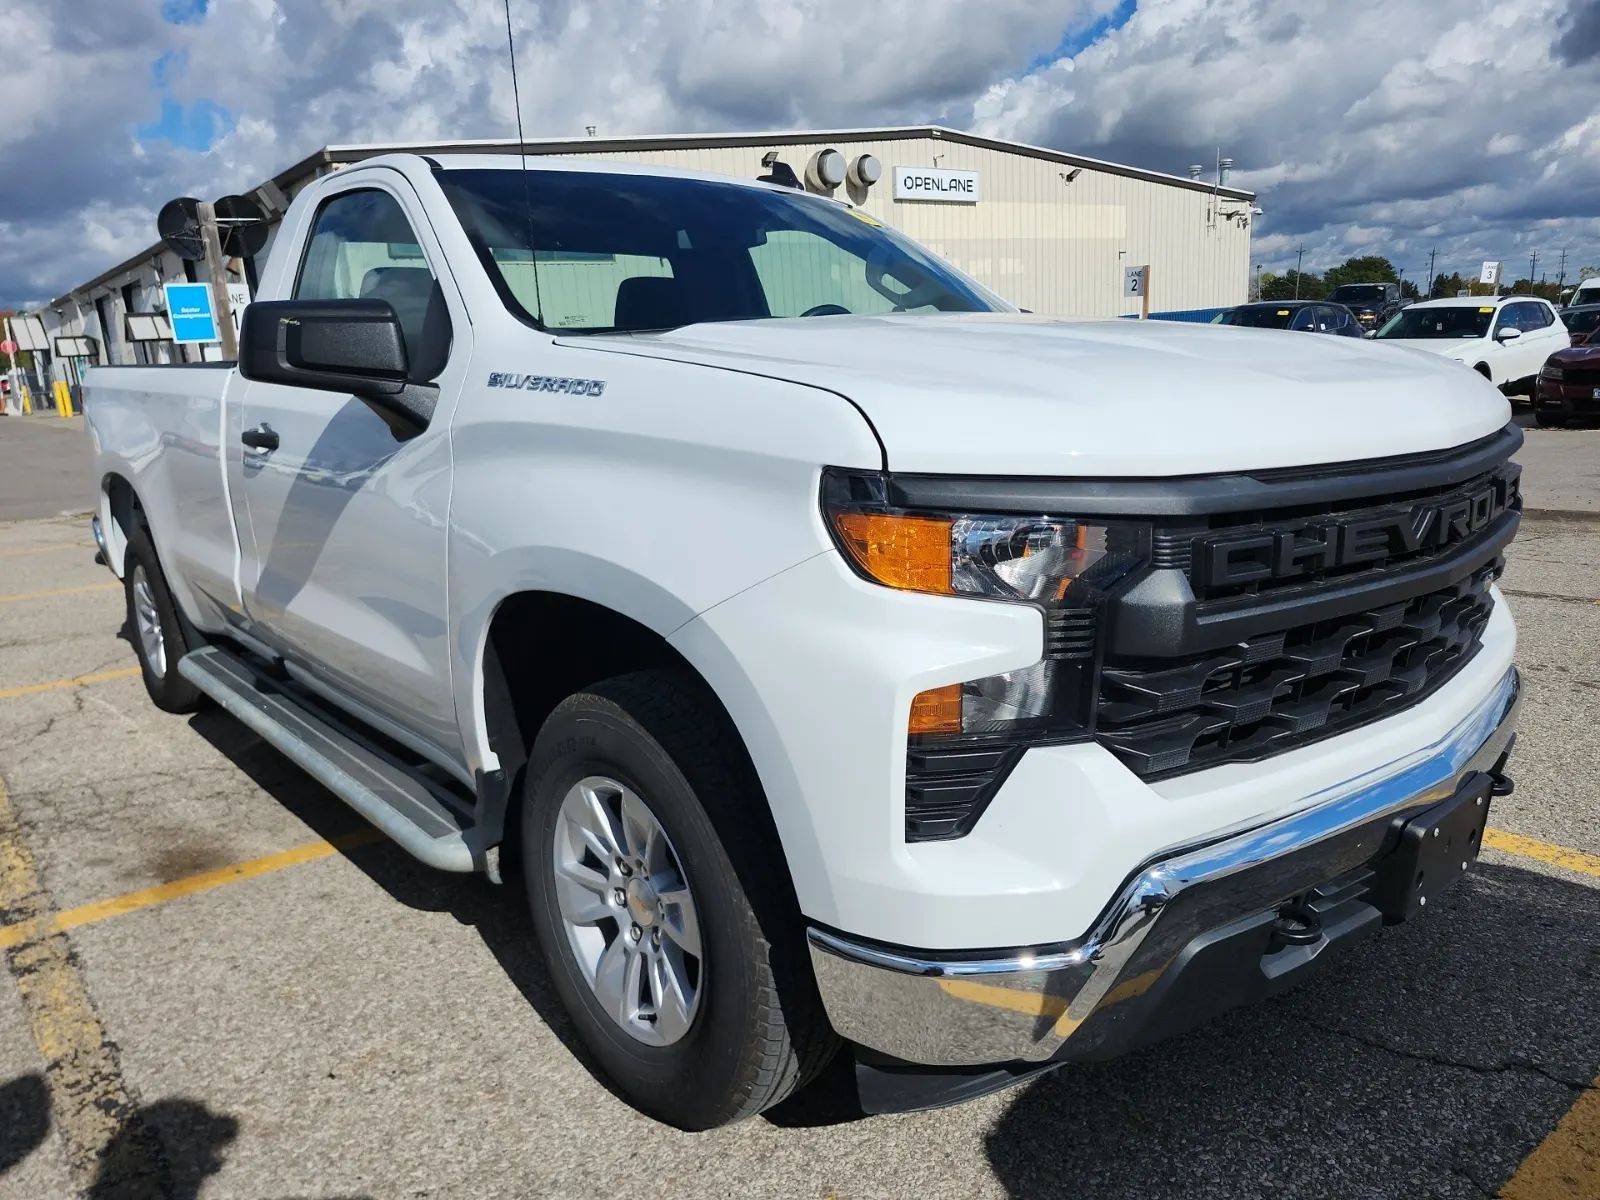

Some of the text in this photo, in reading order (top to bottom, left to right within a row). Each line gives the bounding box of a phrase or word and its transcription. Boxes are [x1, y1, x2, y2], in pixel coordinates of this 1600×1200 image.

[904, 175, 974, 193] OPENLANE
[1487, 271, 1493, 279] 3
[1131, 279, 1138, 291] 2
[231, 309, 239, 330] 1
[487, 372, 607, 397] SILVERADO
[1202, 473, 1520, 587] CHEVROLE
